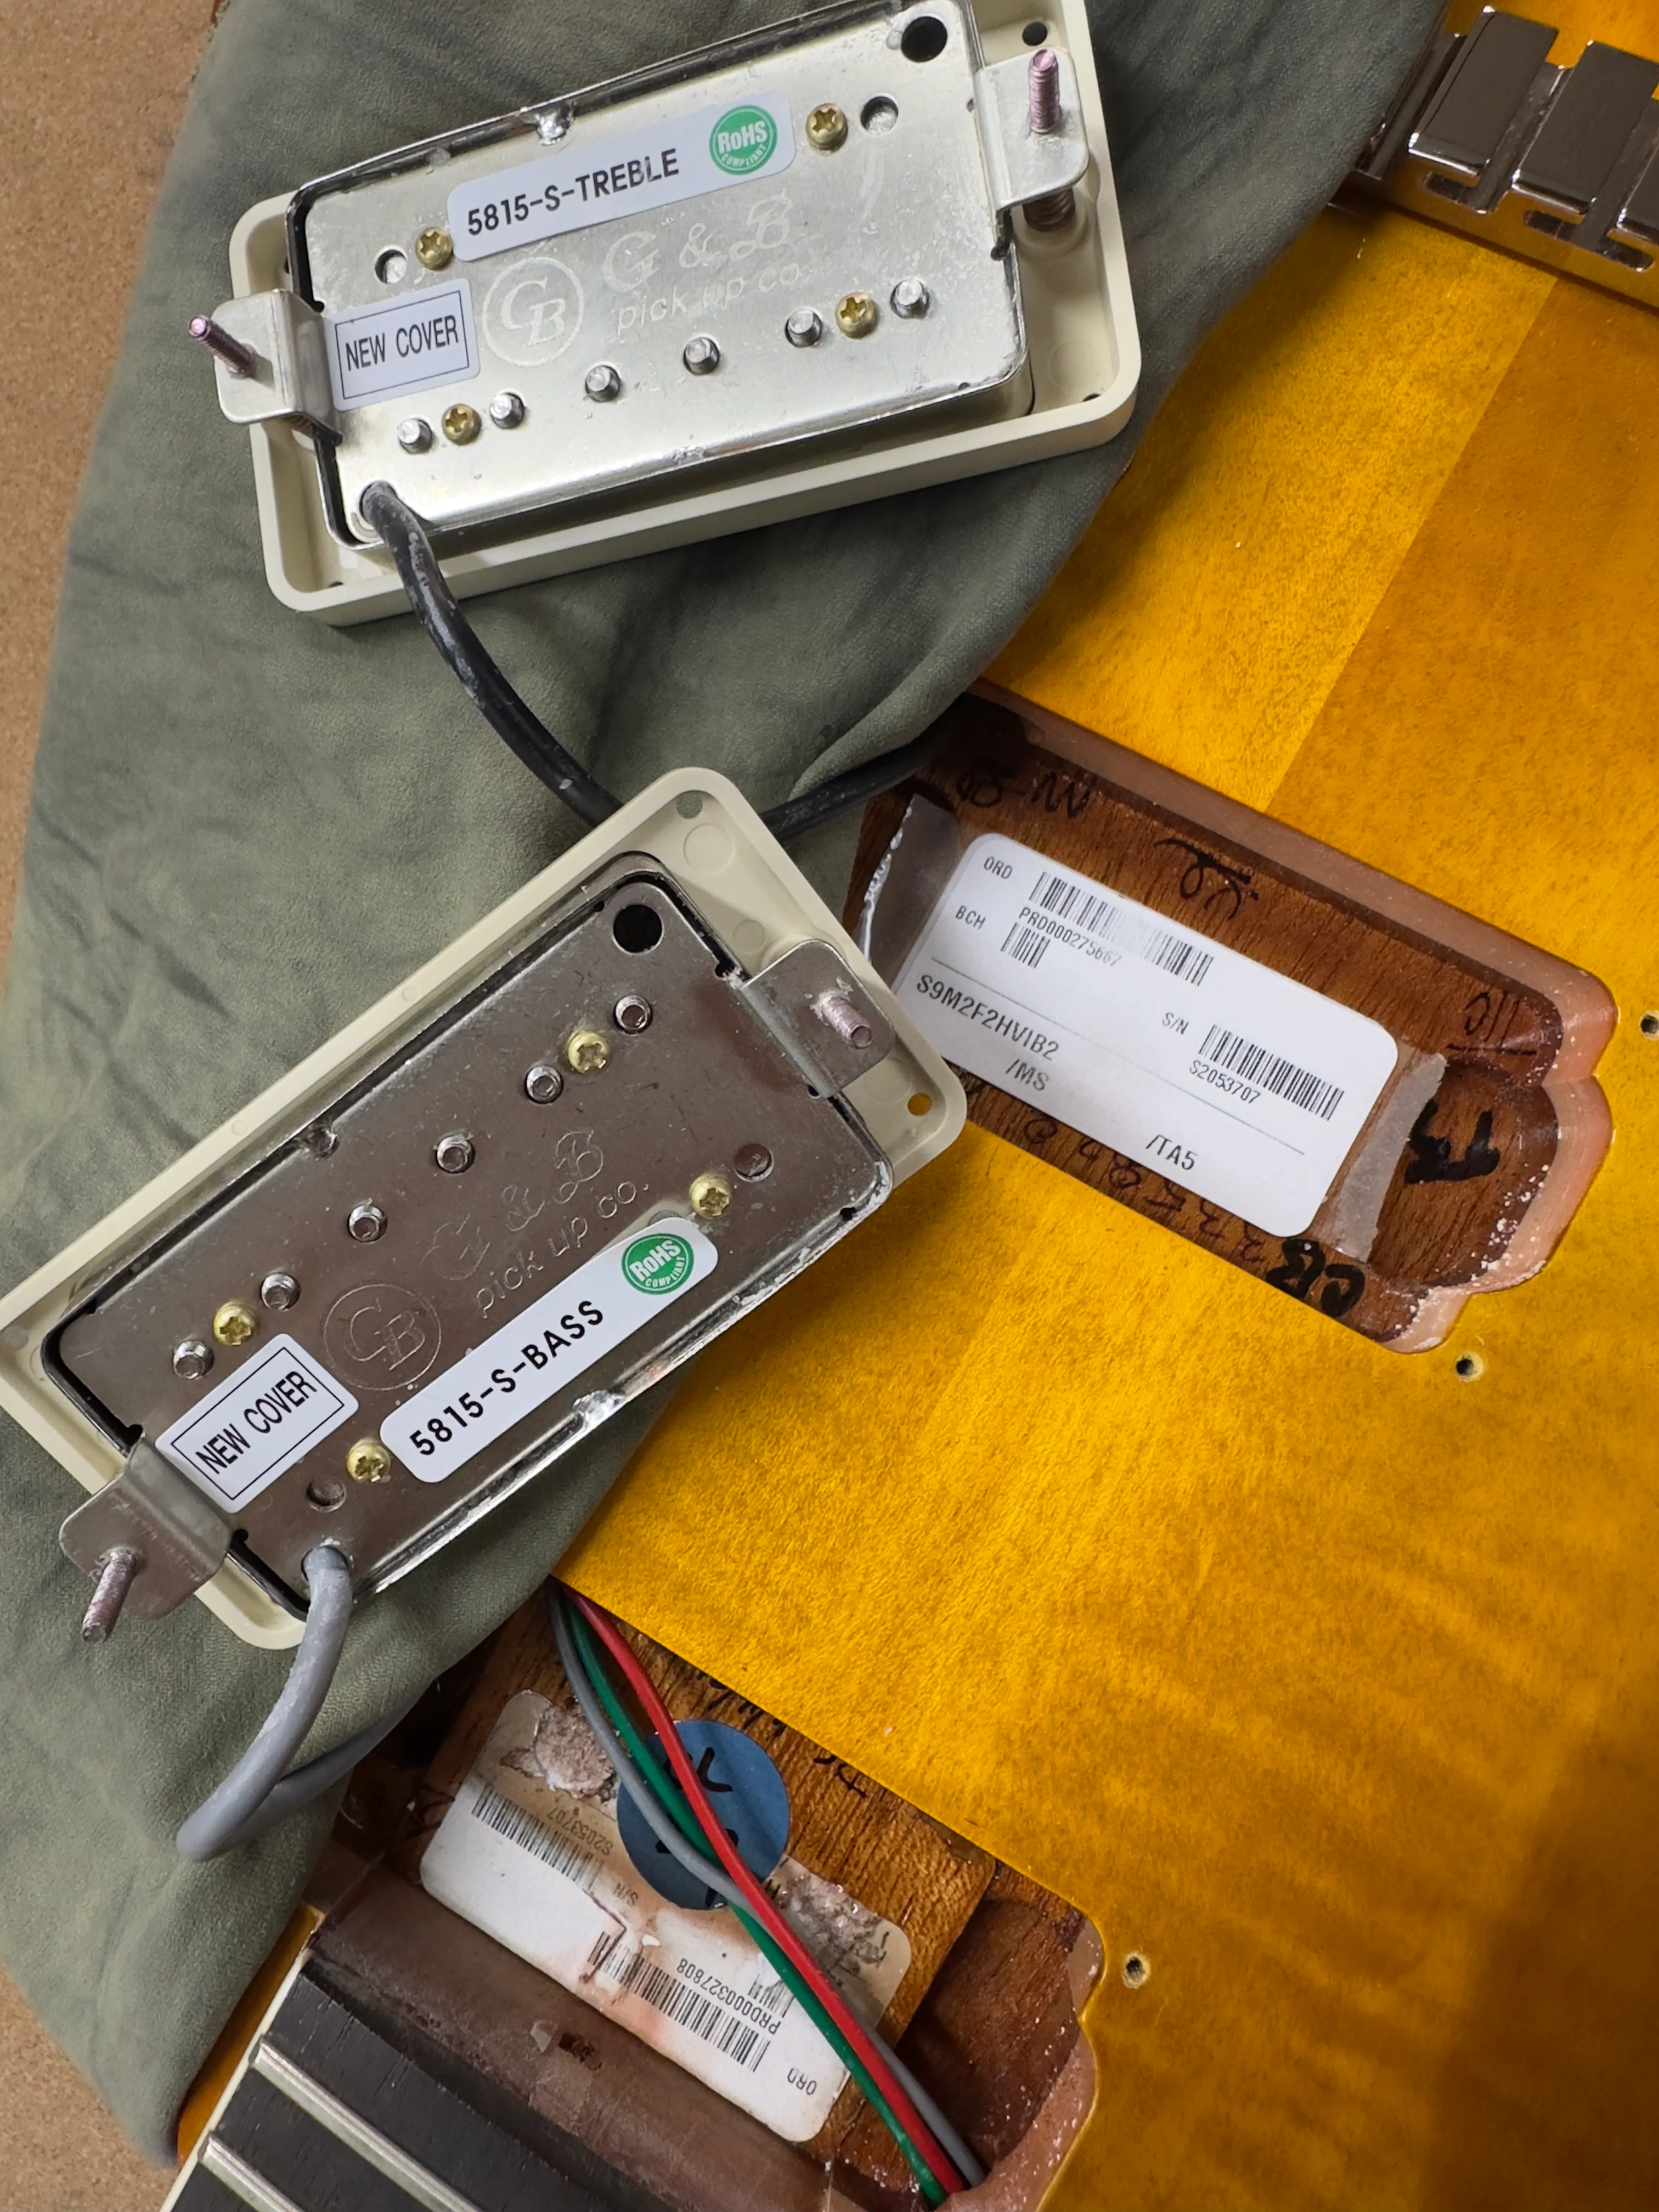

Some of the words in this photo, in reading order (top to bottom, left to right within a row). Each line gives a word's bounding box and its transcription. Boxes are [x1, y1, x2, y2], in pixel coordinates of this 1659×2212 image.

[717, 118, 768, 153] RoHS
[721, 140, 768, 168] COMPLIANT
[467, 148, 680, 236] 5815-S-TREBLE
[616, 285, 687, 337] pick
[702, 276, 744, 311] up
[345, 333, 386, 372] NEW
[396, 314, 460, 359] COVER
[983, 856, 1013, 880] ORD
[955, 905, 987, 930] BCH
[1018, 906, 1122, 967] PRD000275667
[1161, 1011, 1189, 1036] S/N
[1005, 1058, 1051, 1092] /MS
[1188, 1059, 1262, 1105] S2053707
[1145, 1133, 1199, 1172] /TA5
[475, 1250, 544, 1319] pick
[548, 1216, 589, 1257] up
[629, 1235, 682, 1283] RoHS
[644, 1254, 686, 1289] COMPLIANT
[409, 1300, 604, 1455] 5815-S-BASS
[195, 1421, 249, 1475] NEW
[243, 1370, 318, 1435] COVER
[549, 1807, 614, 1857] S2053707
[616, 1882, 639, 1908] S/N
[676, 1957, 782, 2035] PRD000327808
[787, 2067, 817, 2096] ORD
